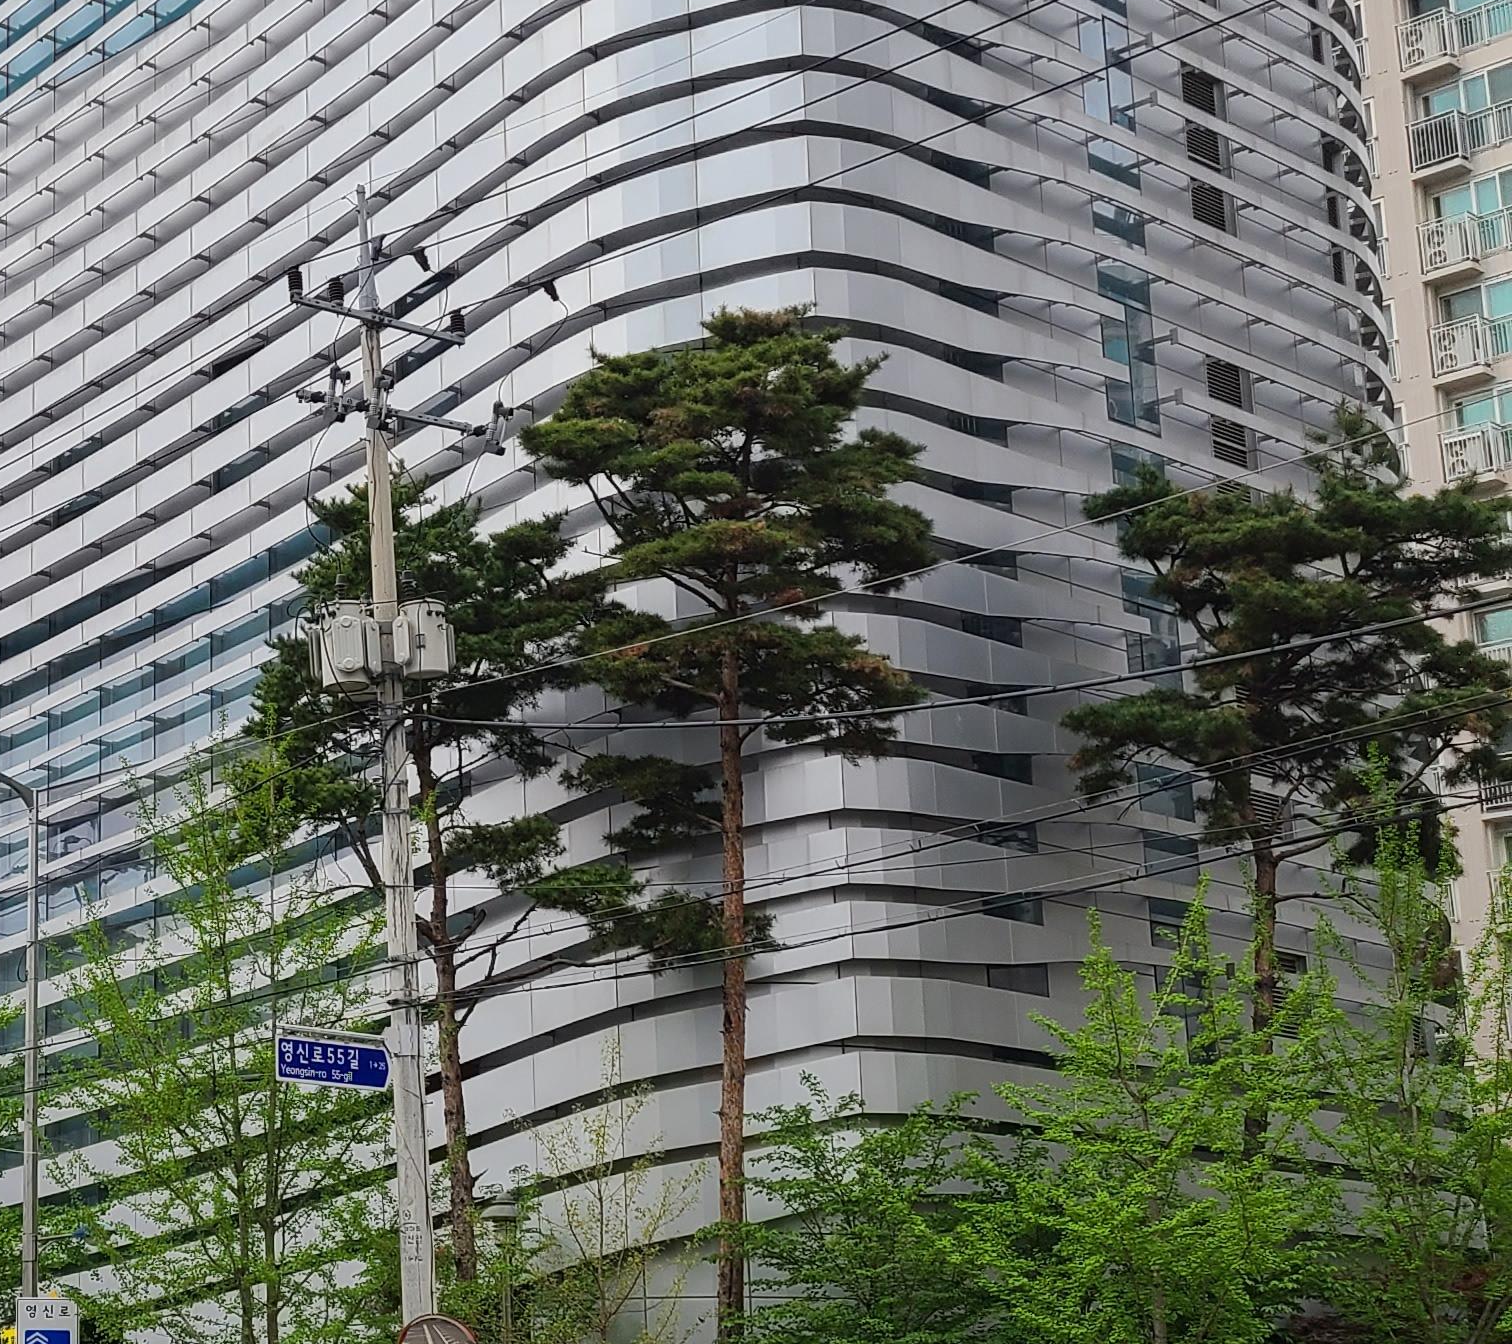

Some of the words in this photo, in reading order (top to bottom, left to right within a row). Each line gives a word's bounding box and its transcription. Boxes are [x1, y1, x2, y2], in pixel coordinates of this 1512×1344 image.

[280, 1041, 360, 1070] 영신로55길
[280, 1063, 327, 1079] Yeongsin-ro
[331, 1069, 353, 1083] 55-gil
[26, 1305, 71, 1319] 영신로
